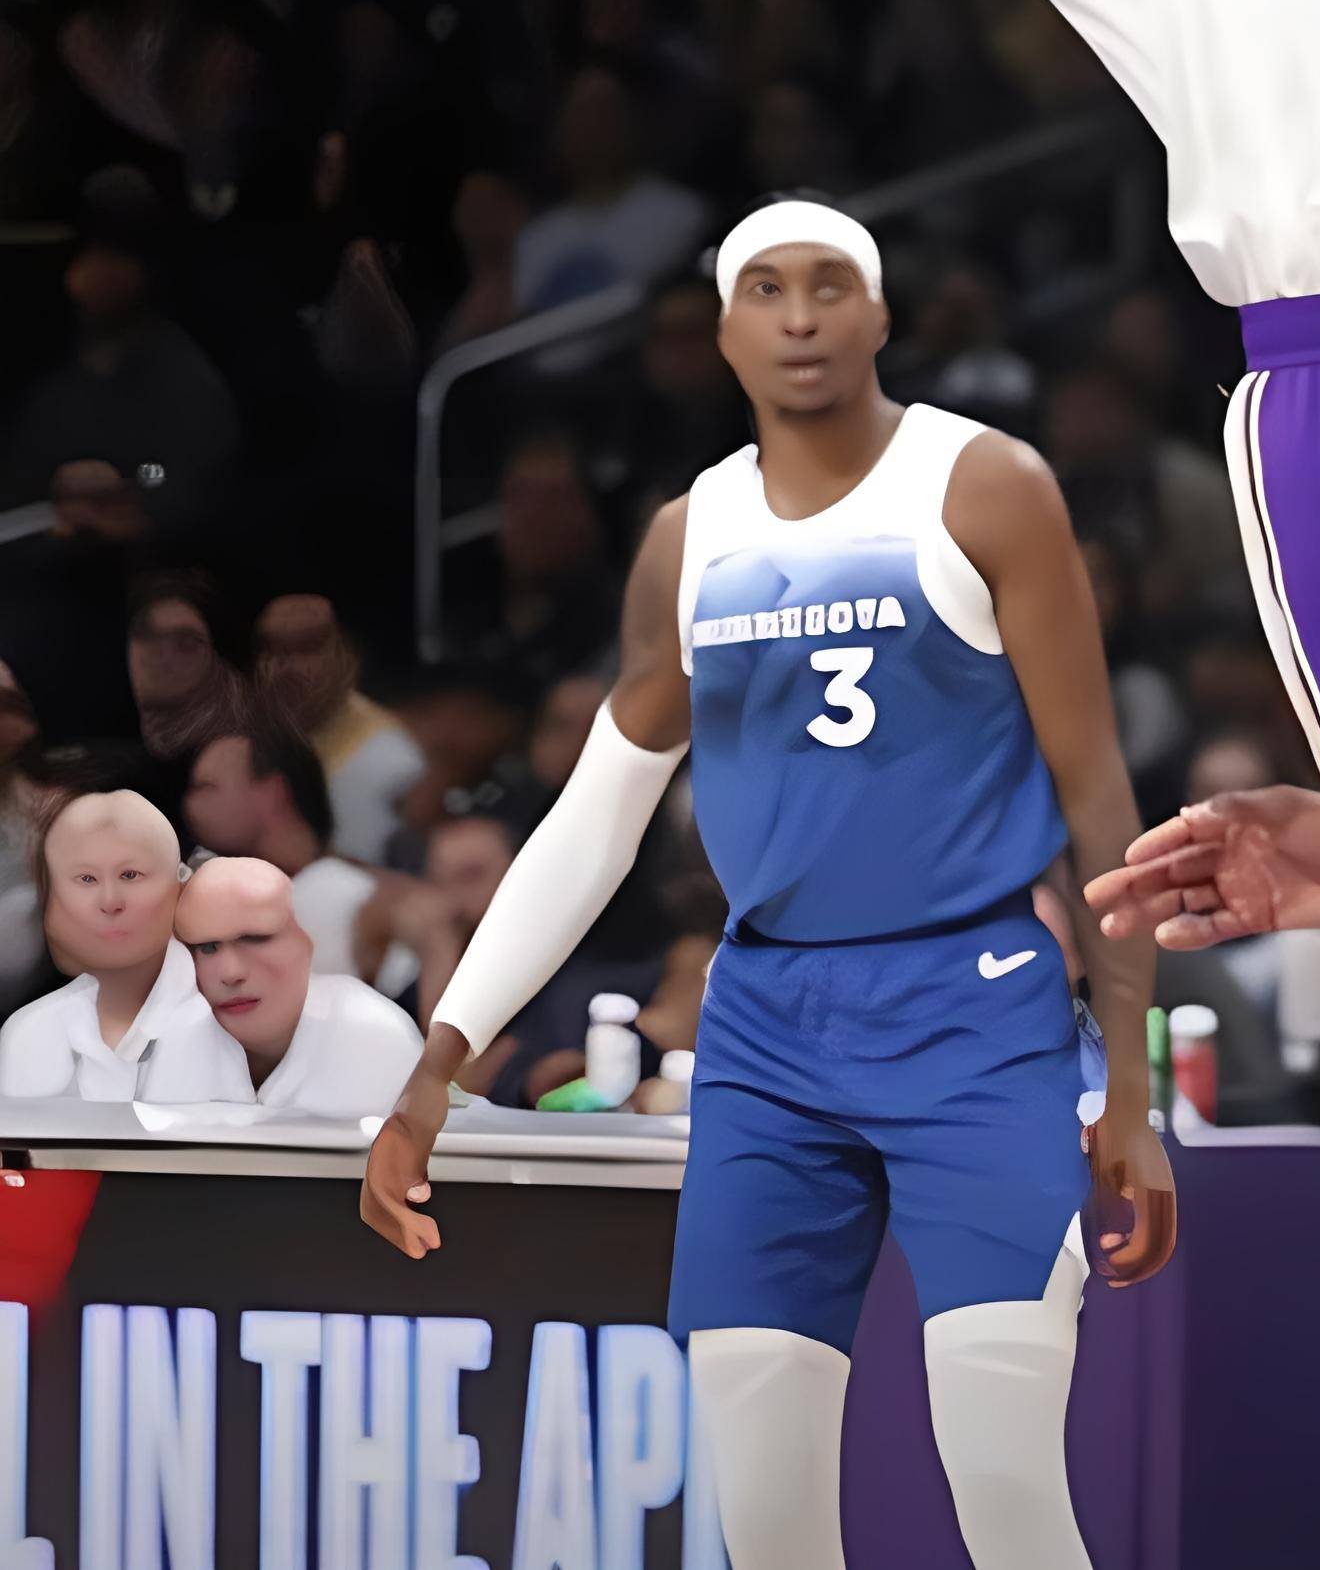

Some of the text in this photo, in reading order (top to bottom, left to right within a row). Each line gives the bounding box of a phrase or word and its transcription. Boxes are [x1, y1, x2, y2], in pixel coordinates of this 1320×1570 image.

[806, 646, 876, 748] 3
[79, 1304, 217, 1570] IN
[240, 1310, 492, 1570] THE
